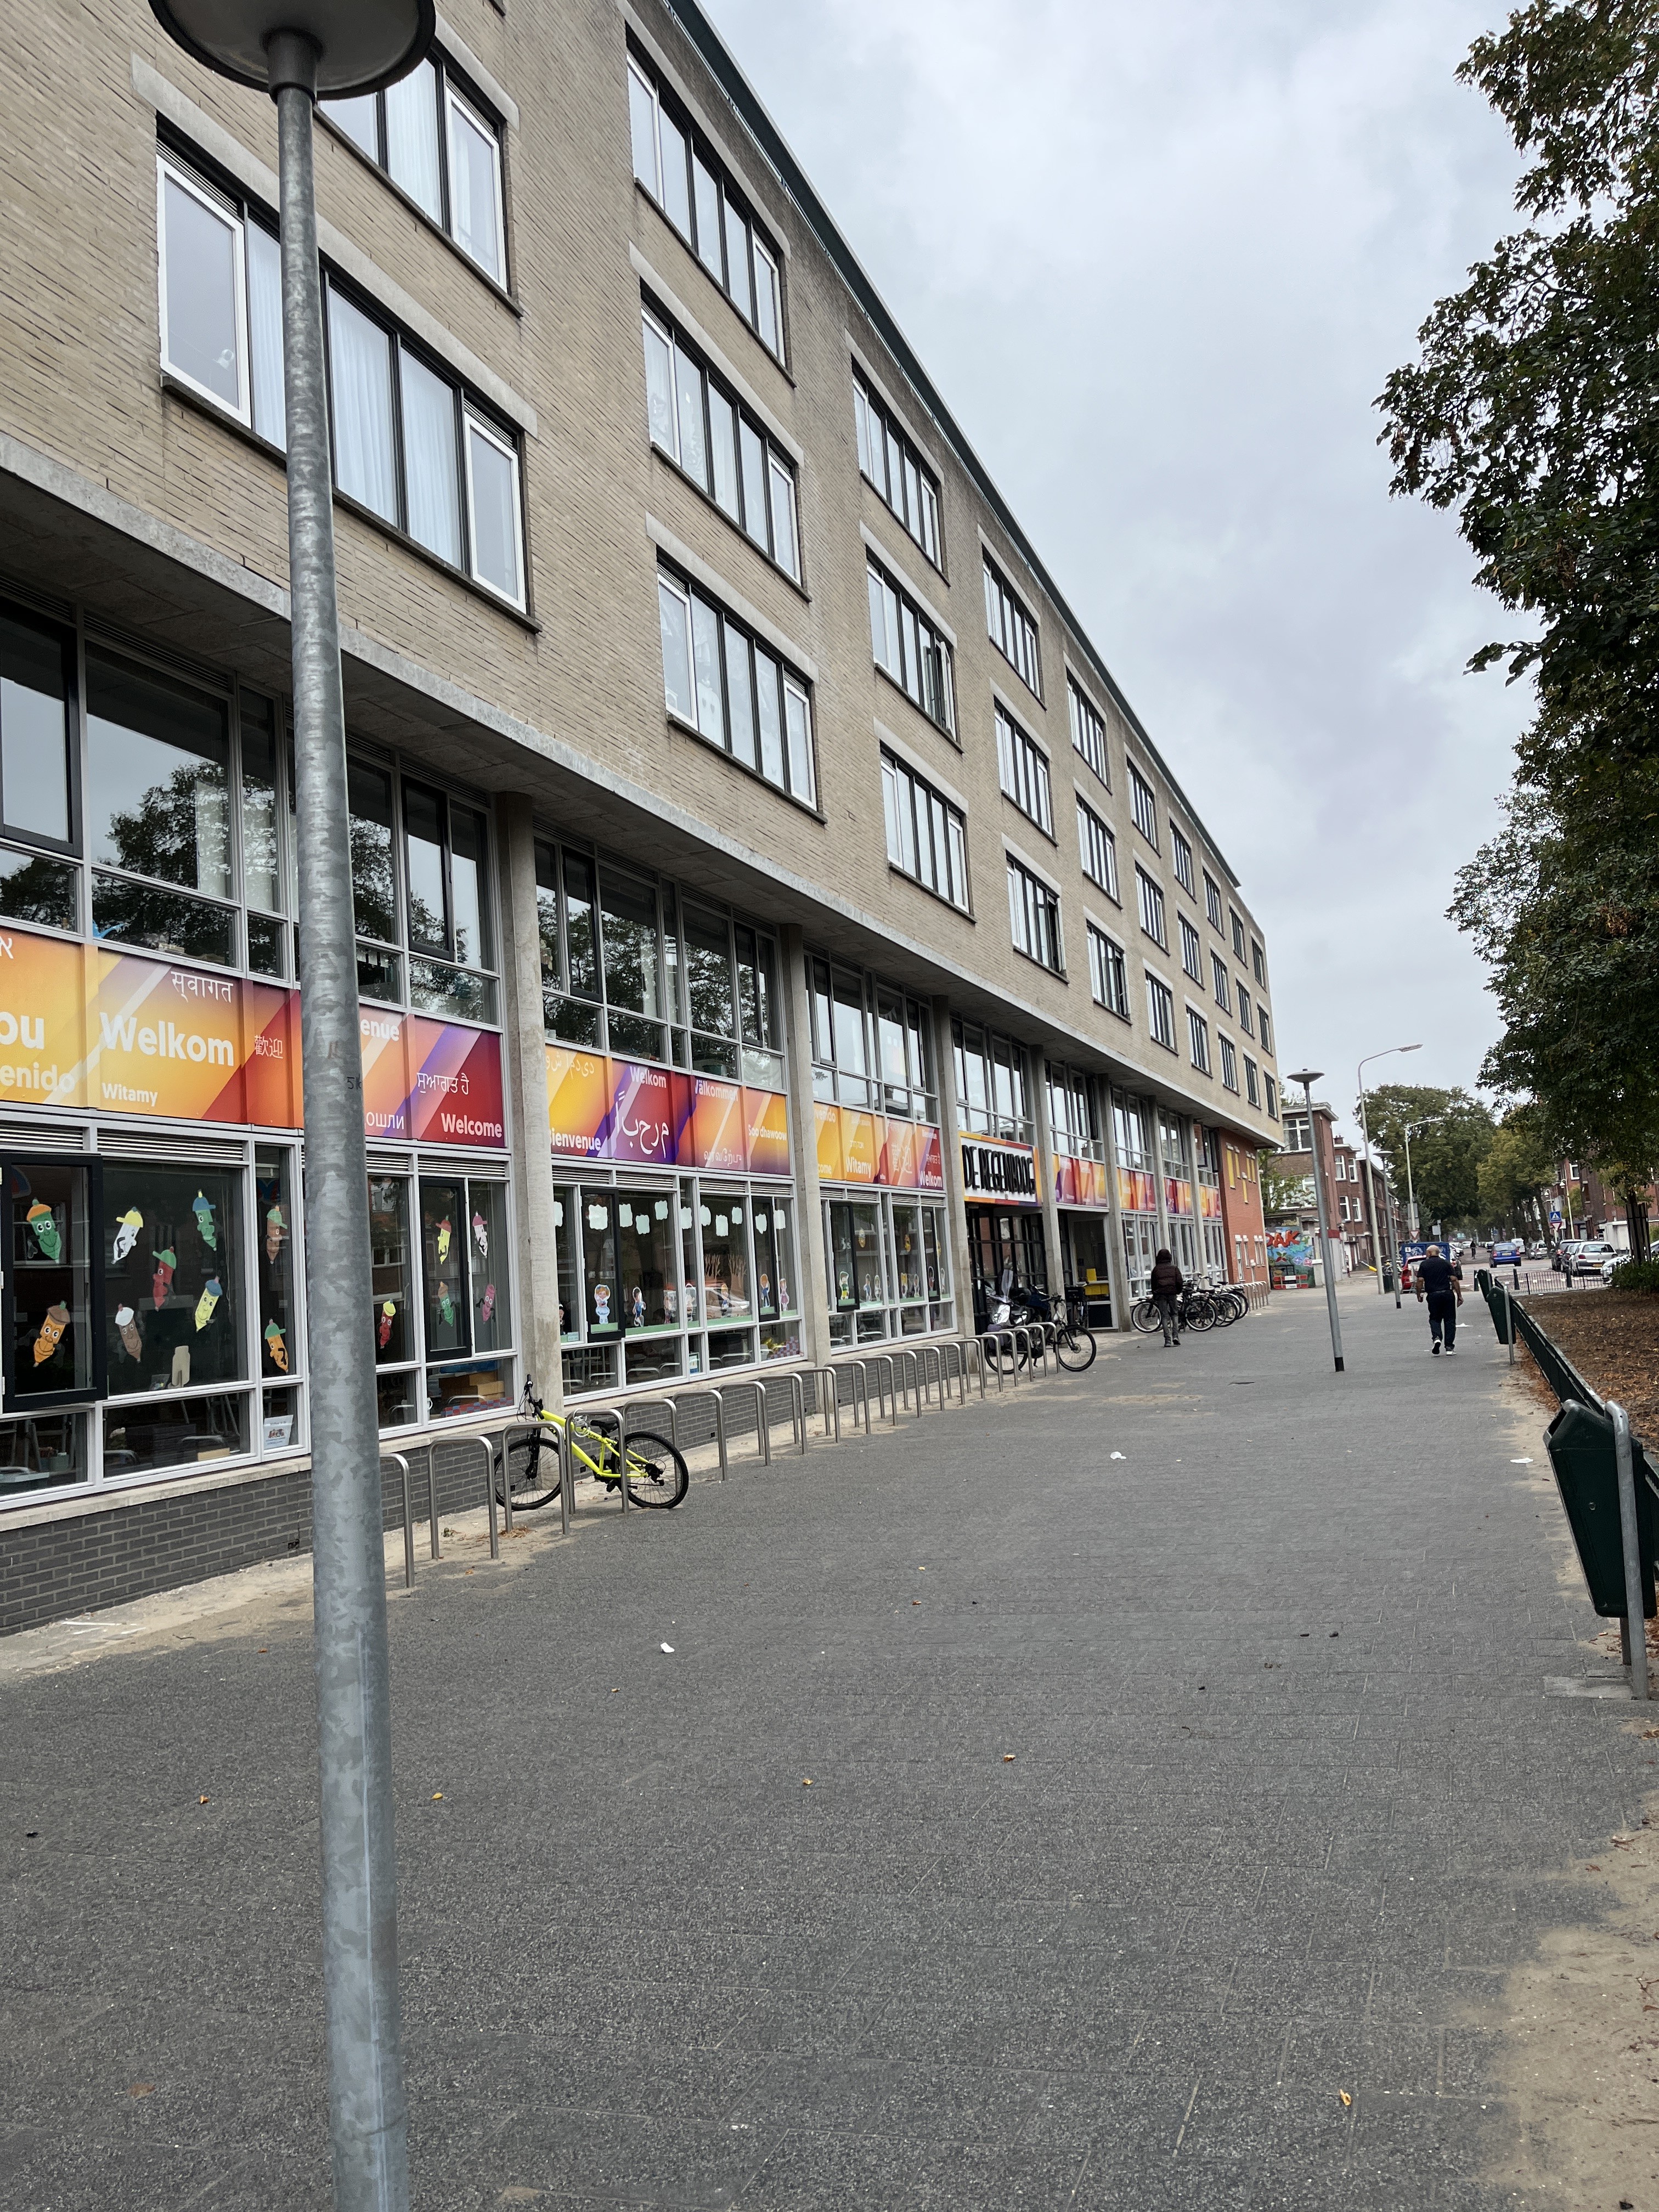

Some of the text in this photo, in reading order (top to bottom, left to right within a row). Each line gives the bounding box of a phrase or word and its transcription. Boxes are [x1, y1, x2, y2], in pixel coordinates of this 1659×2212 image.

[0, 1011, 44, 1049] ou
[99, 1012, 234, 1066] Welkom
[254, 1035, 284, 1059] 歡迎
[0, 1062, 76, 1093] enido
[629, 1066, 667, 1088] Welkom
[102, 1082, 158, 1107] Witamy
[695, 1079, 738, 1102] Välkommen
[441, 1113, 503, 1138] Welcome
[815, 1108, 836, 1123] venido
[549, 1127, 601, 1151] ienvenue
[817, 1163, 832, 1175] come
[846, 1156, 872, 1179] Witamy
[920, 1170, 943, 1188] Welkom
[962, 1144, 980, 1189] DE
[978, 1148, 1035, 1195] REGENBOOG
